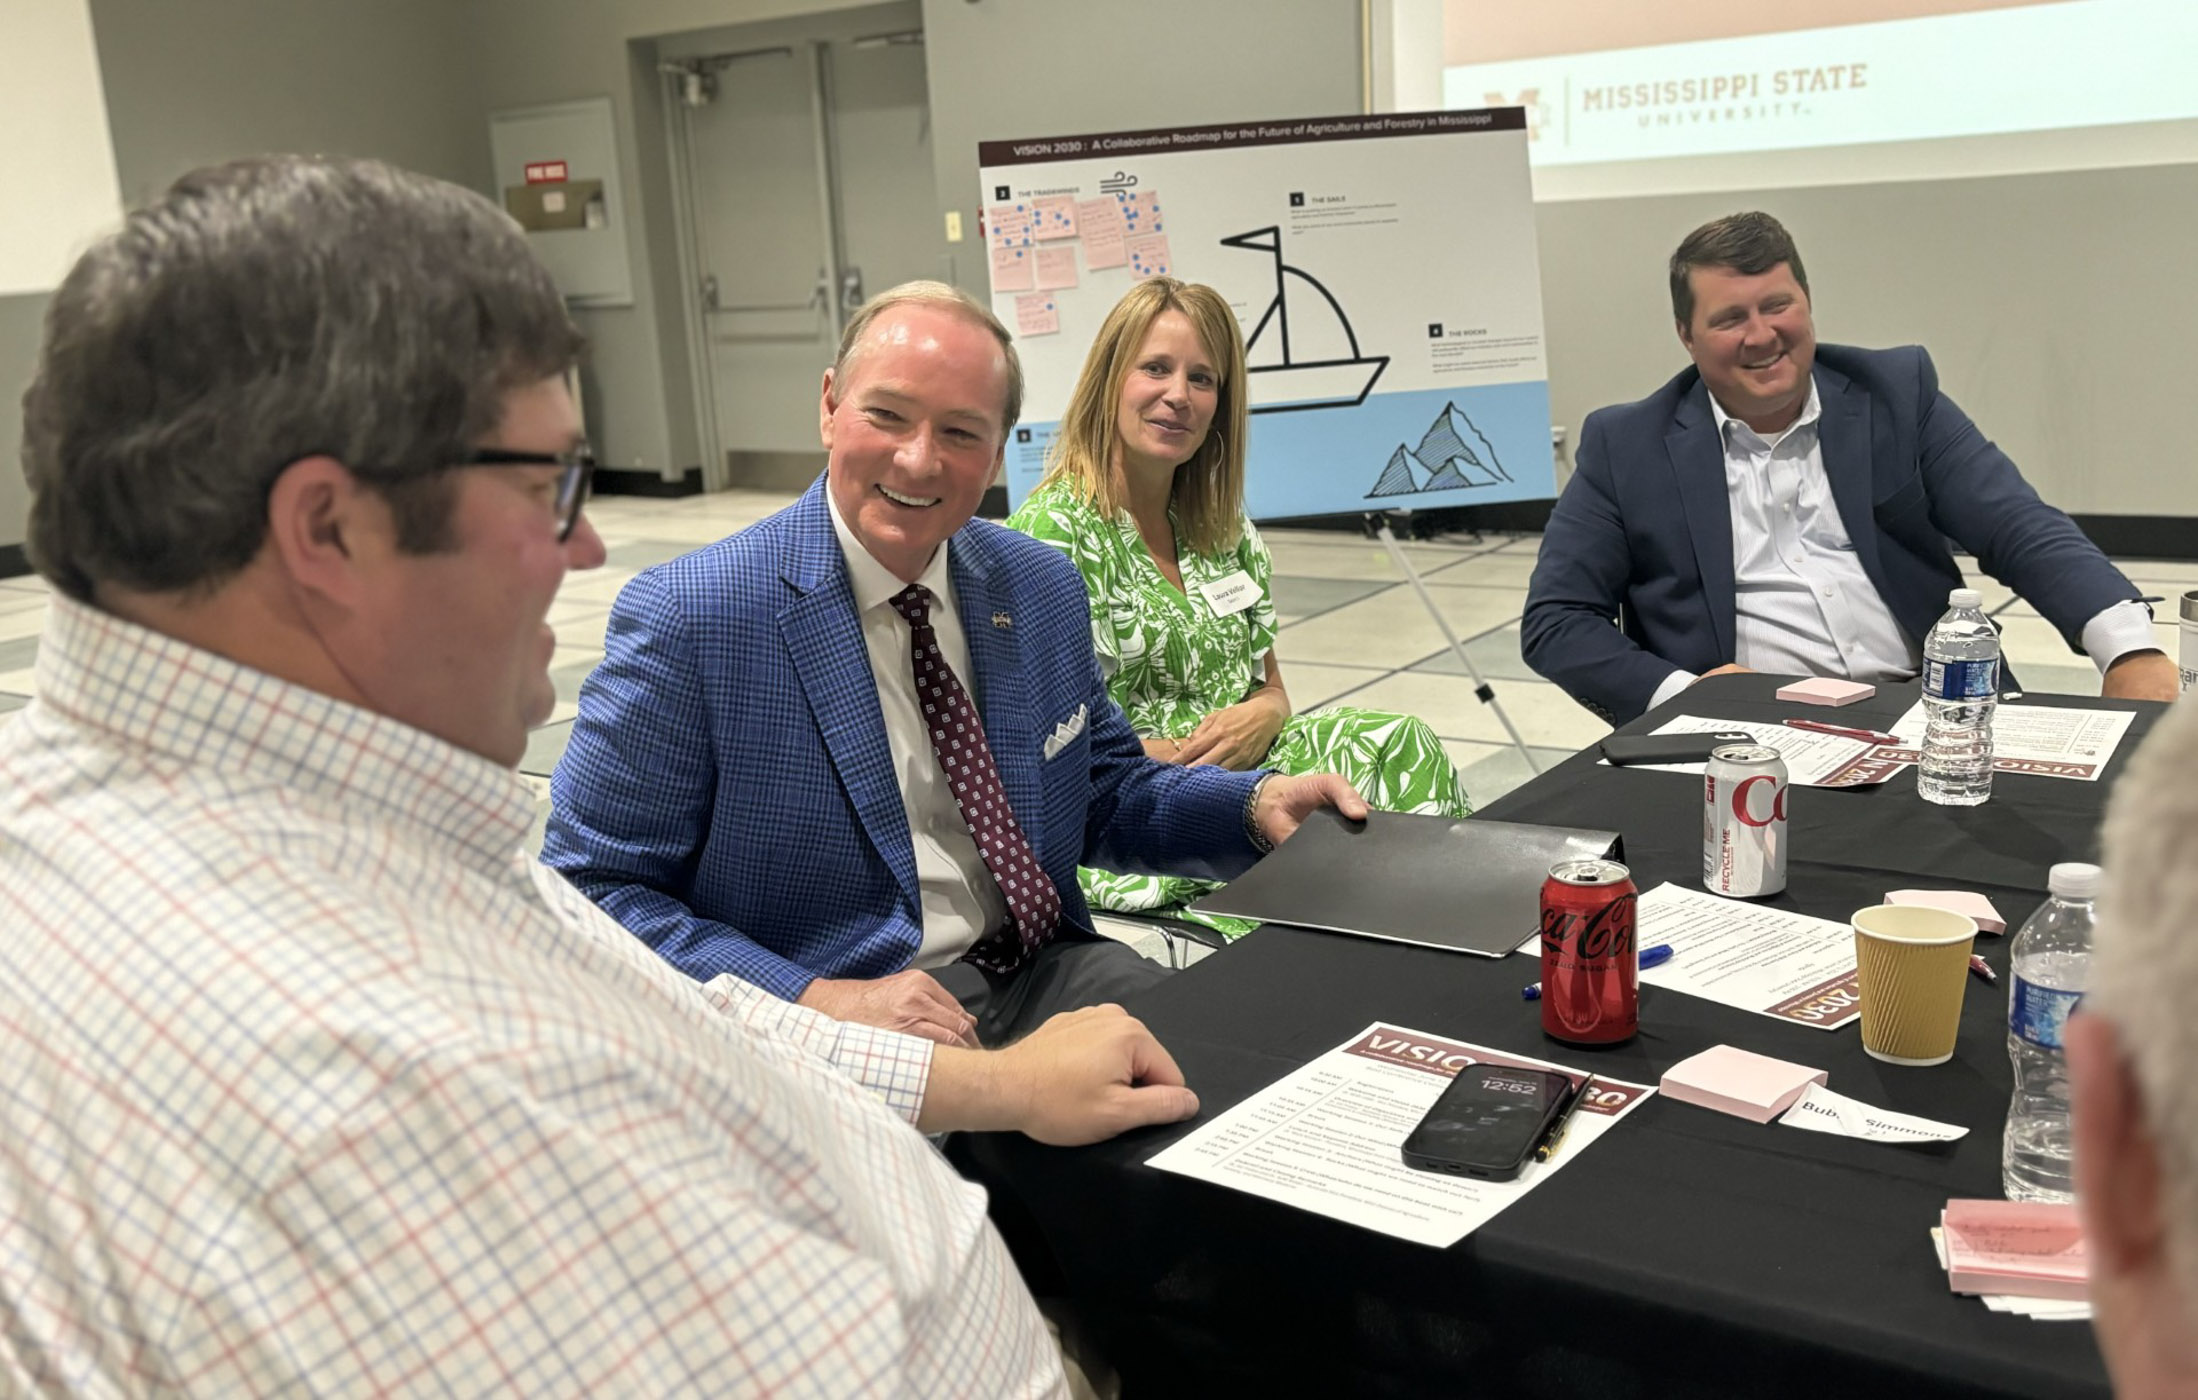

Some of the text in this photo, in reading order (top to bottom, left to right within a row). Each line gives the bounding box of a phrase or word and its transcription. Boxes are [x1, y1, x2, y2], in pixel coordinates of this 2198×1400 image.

[1583, 63, 1869, 112] MISSISSIPPI STATE
[1013, 145, 1052, 157] VISION
[1054, 142, 1083, 154] 2030
[1091, 140, 1101, 151] A
[1102, 134, 1171, 149] Collaborative
[1172, 130, 1221, 146] Roadmap
[1223, 130, 1237, 141] for
[1239, 128, 1257, 139] the
[1258, 125, 1291, 138] Future
[1293, 124, 1305, 136] of
[1306, 120, 1361, 136] Agriculture
[1362, 119, 1383, 131] and
[1384, 117, 1426, 131] Forestry
[1427, 115, 1437, 127] in
[1438, 113, 1492, 128] Mississippi
[1638, 103, 1803, 128] UNIVERSITY
[1993, 760, 2088, 776] VISIO
[1732, 775, 1788, 827] Co
[1722, 828, 1731, 892] RECYCLE ME
[1368, 1034, 1628, 1107] VISIO 30
[1481, 1080, 1537, 1096] 12:52
[1802, 1101, 1840, 1119] Bub
